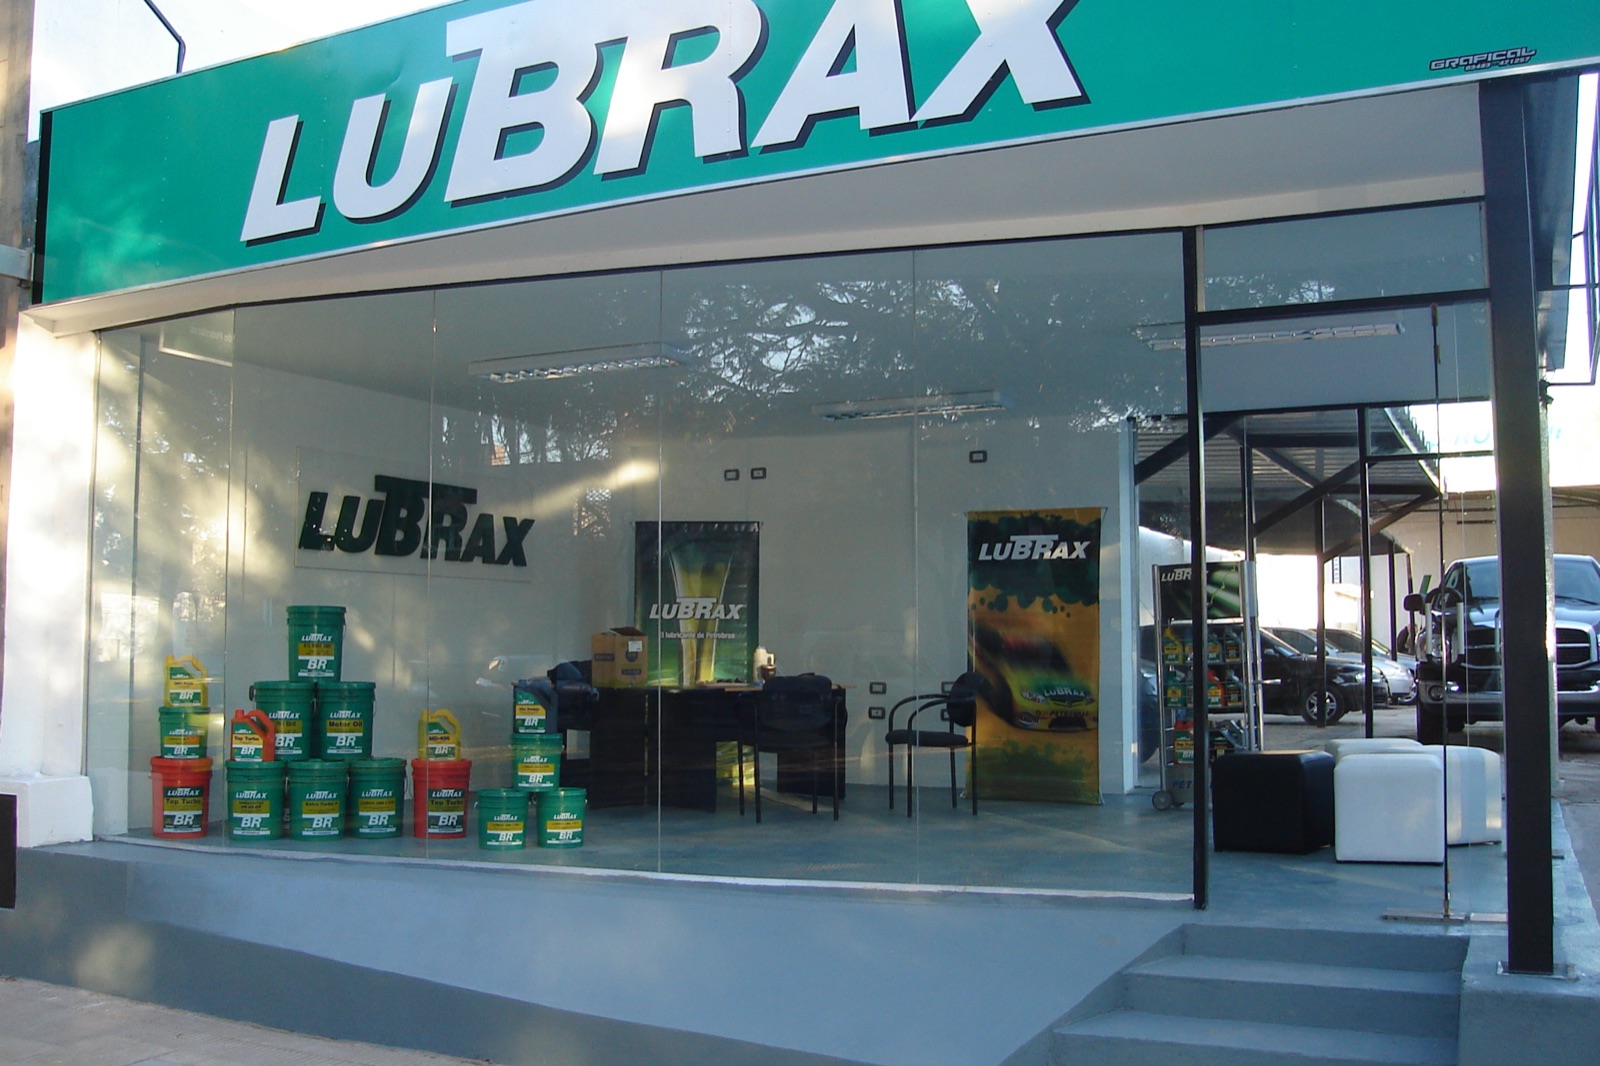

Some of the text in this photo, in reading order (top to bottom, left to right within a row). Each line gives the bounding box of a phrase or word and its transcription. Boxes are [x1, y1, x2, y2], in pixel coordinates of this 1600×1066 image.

[240, 0, 1088, 243] LUBRAX
[298, 474, 536, 567] LUBRAX
[978, 534, 1091, 560] LUBRAX
[1161, 568, 1193, 582] LUBR
[649, 597, 744, 619] LUBRAX
[301, 633, 332, 642] LUBRAX
[665, 631, 696, 639] lubricante
[307, 660, 328, 670] BR
[179, 691, 194, 700] BR
[1044, 687, 1086, 697] LUBRAX
[268, 710, 300, 719] LUBRAX
[330, 710, 361, 719] LUBRAX
[353, 720, 363, 728] Oil
[524, 718, 539, 727] BR
[275, 735, 295, 747] BR
[335, 735, 356, 747] BR
[174, 747, 188, 755] BR
[241, 747, 255, 755] BR
[435, 746, 449, 755] BR
[529, 774, 543, 783] BR
[167, 787, 200, 796] LUBRAX
[235, 790, 267, 799] LUBRAX
[305, 790, 338, 800] LUBRAX
[361, 788, 393, 797] LUBRAX
[432, 789, 463, 798] LUBRAX
[173, 814, 195, 826] BR
[241, 816, 262, 828] BR
[312, 816, 333, 828] BR
[368, 814, 389, 826] BR
[438, 815, 458, 826] BR
[499, 832, 514, 841] BR
[559, 831, 574, 840] BR
